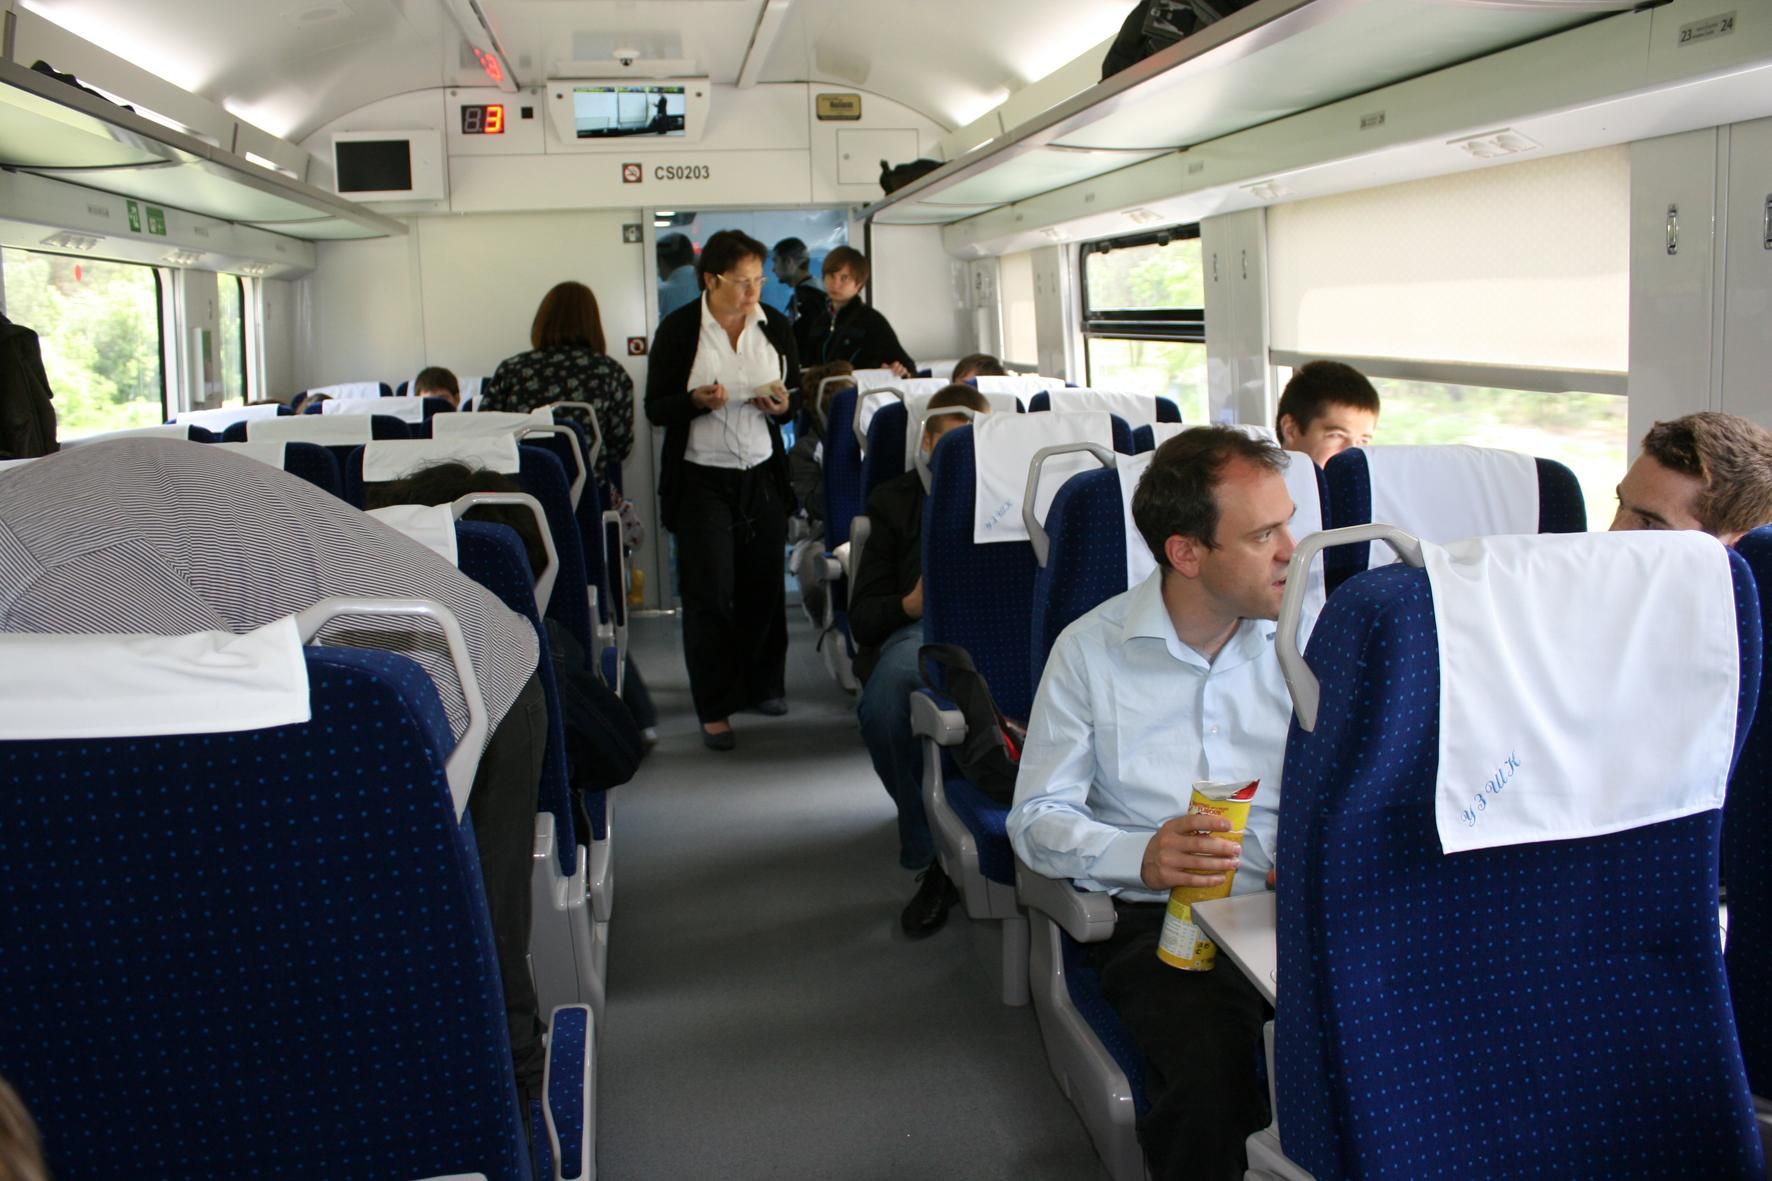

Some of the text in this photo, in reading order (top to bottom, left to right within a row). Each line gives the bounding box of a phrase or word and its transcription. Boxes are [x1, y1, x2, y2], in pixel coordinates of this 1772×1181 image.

[1681, 29, 1692, 43] 23
[1720, 17, 1733, 32] 24
[484, 106, 503, 133] 3
[654, 165, 710, 181] CS0203
